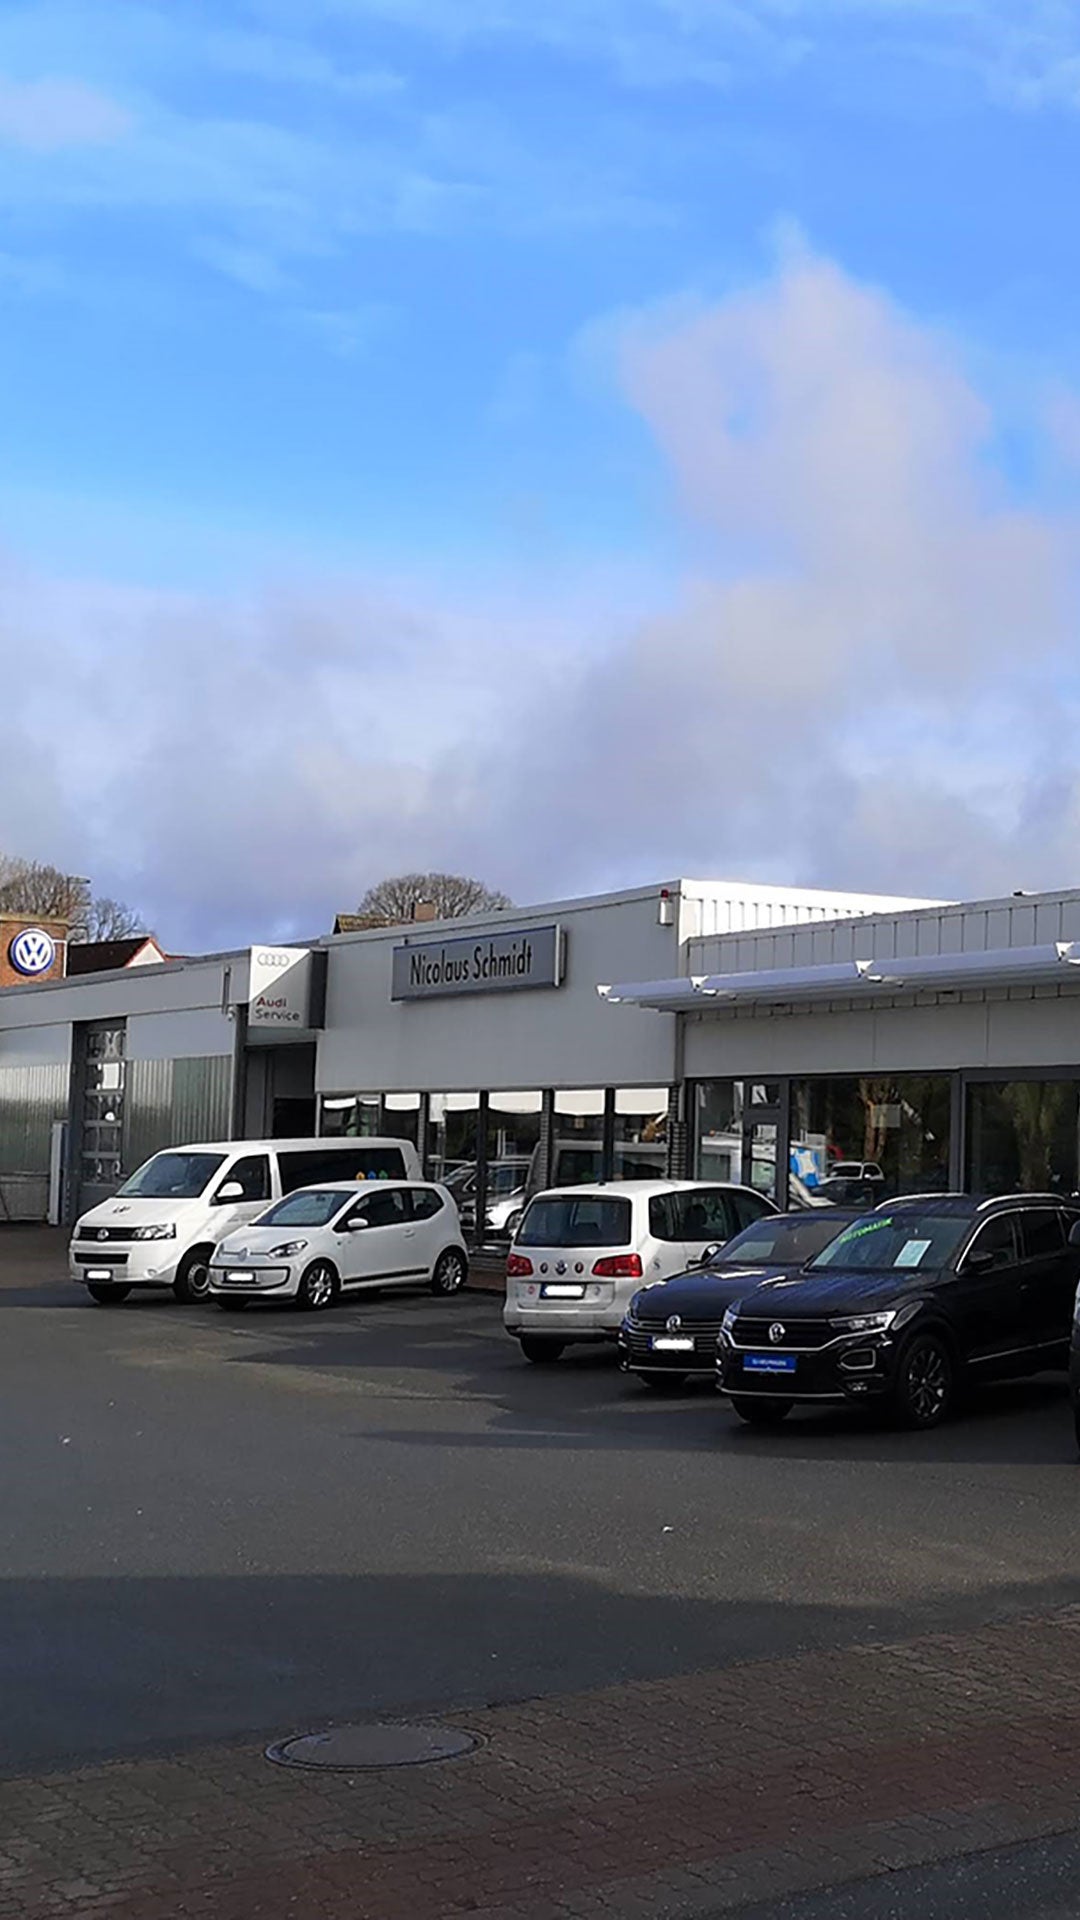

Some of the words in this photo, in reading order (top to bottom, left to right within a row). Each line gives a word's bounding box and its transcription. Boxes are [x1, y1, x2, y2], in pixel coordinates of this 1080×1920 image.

[410, 949, 469, 985] Nicolaus
[473, 939, 532, 979] Schmidt
[256, 996, 287, 1008] Audi
[255, 1008, 300, 1021] Service
